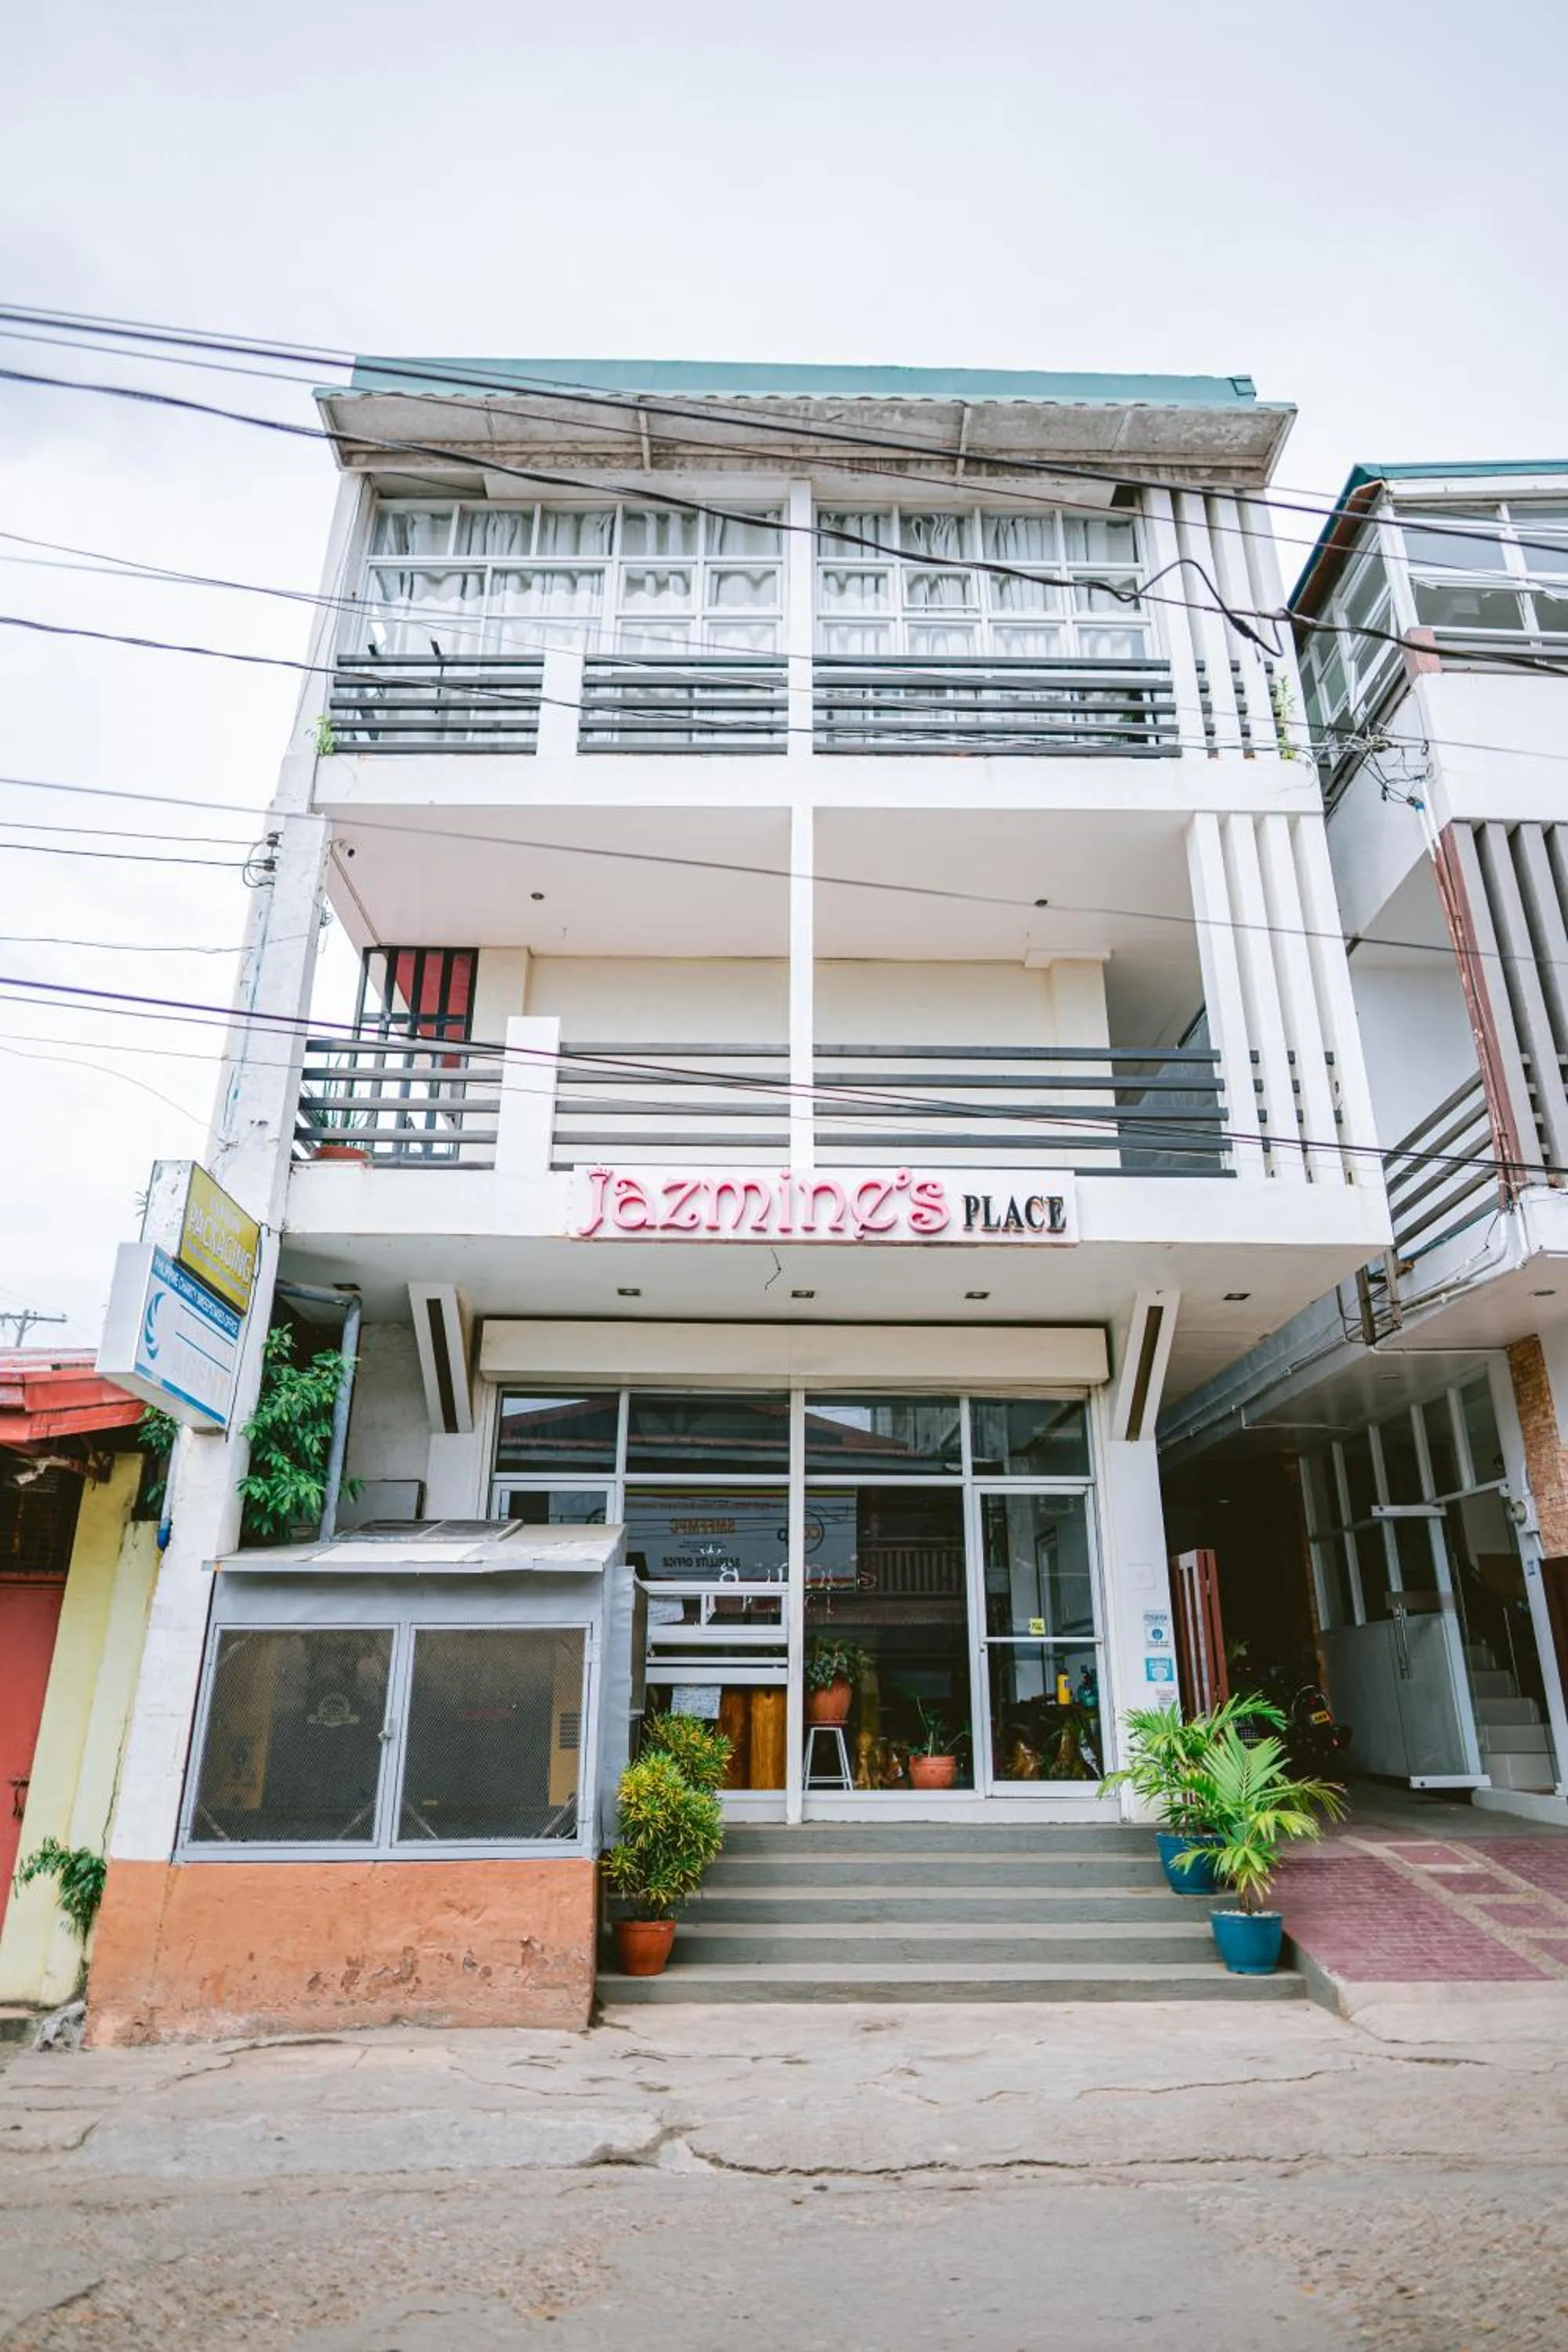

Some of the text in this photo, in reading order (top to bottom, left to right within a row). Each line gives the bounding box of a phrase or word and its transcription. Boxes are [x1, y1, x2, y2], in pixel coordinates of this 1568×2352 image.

[578, 1163, 1067, 1239] Jazmine's PLACE
[189, 1201, 252, 1283] PACKAGING
